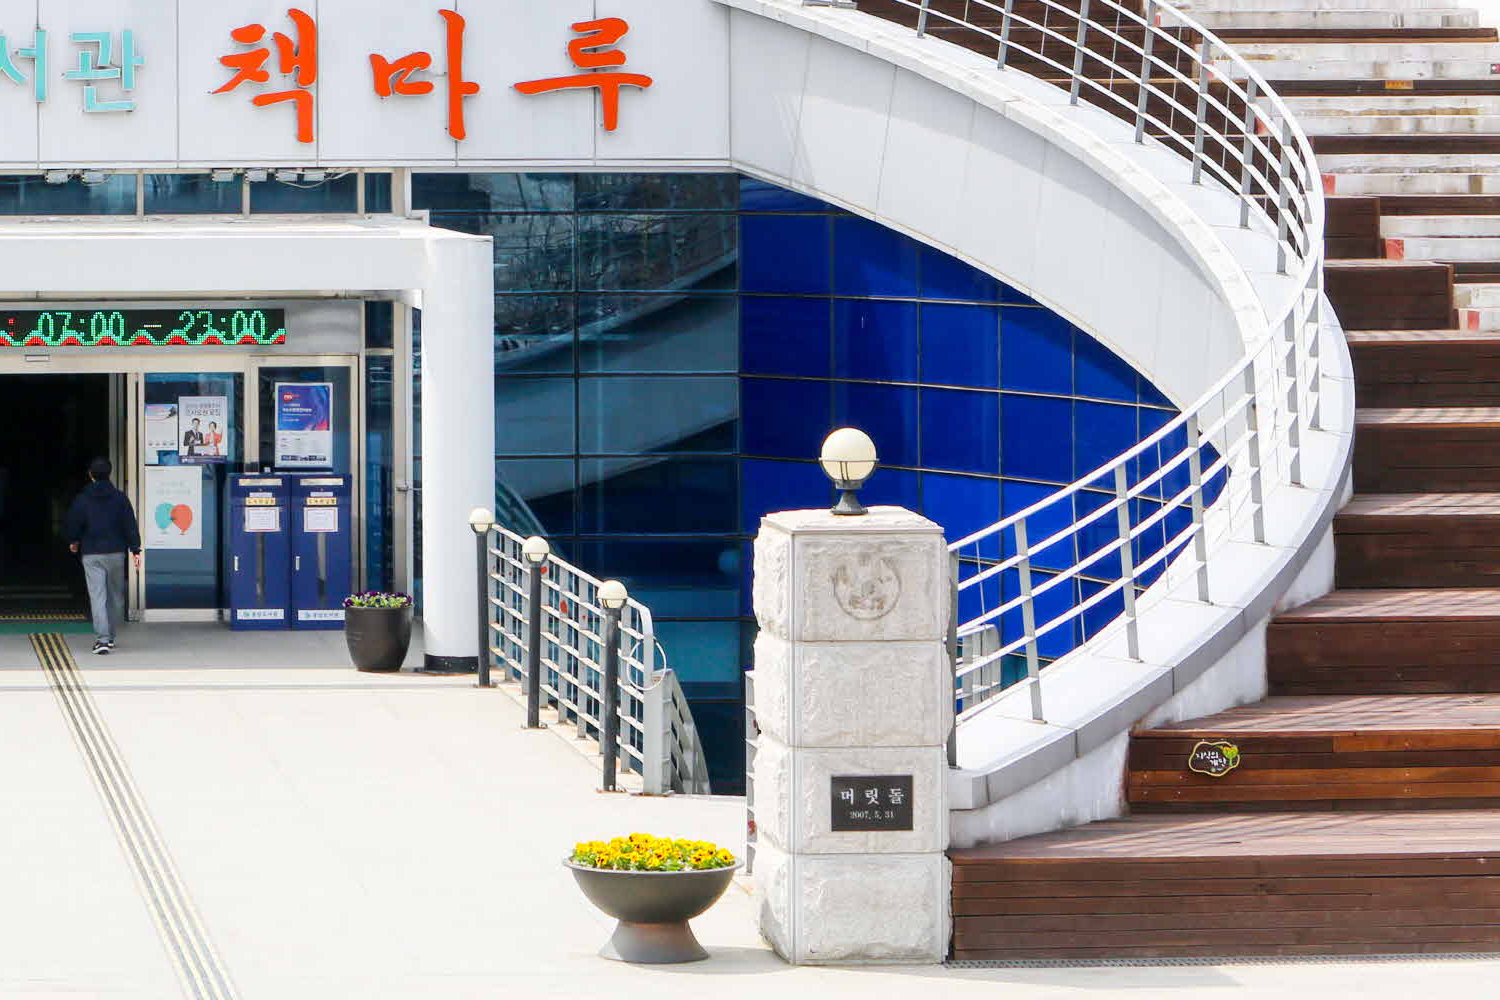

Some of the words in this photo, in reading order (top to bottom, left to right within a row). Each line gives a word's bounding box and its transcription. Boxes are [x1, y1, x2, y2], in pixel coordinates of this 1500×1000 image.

[209, 7, 653, 144] 책마루
[38, 311, 125, 339] 07:00
[178, 310, 266, 338] 23:00
[841, 788, 904, 805] 머릿돌
